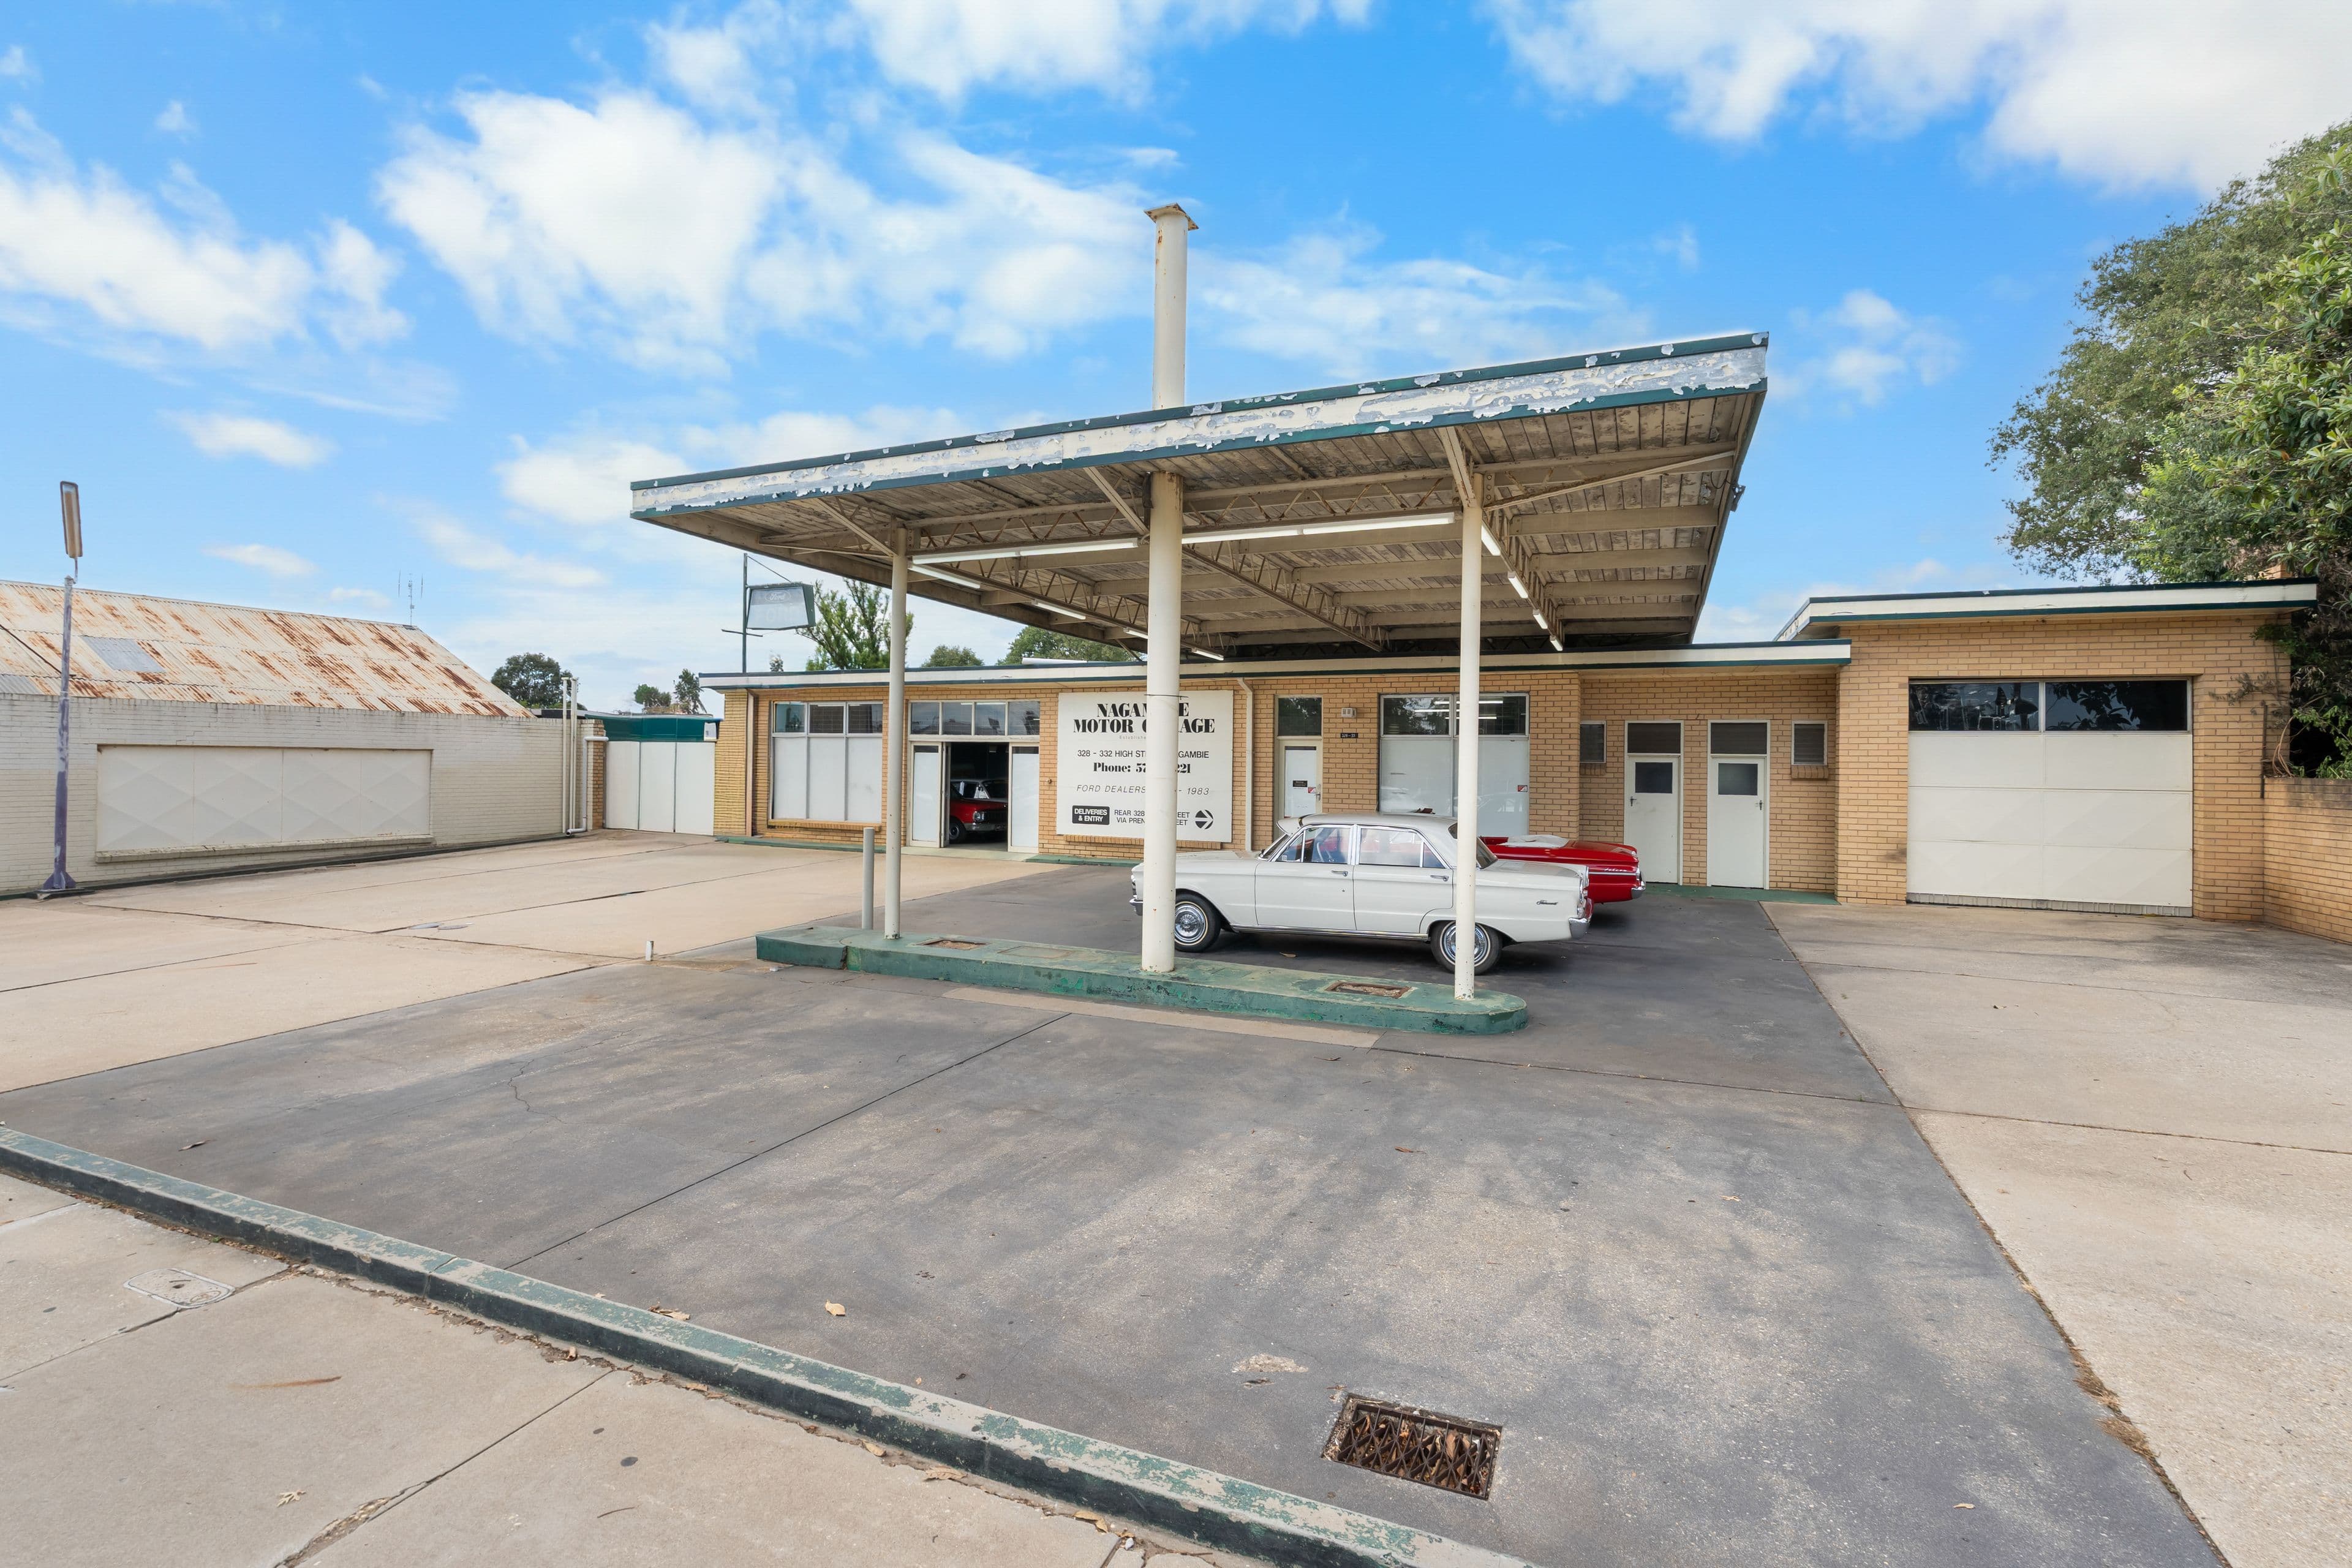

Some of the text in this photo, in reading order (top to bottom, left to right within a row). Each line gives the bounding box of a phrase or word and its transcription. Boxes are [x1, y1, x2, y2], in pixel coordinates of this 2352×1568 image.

[1074, 718, 1134, 733] MOTOR
[1093, 762, 1131, 773] Phone:
[1104, 785, 1146, 794] DEALERS
